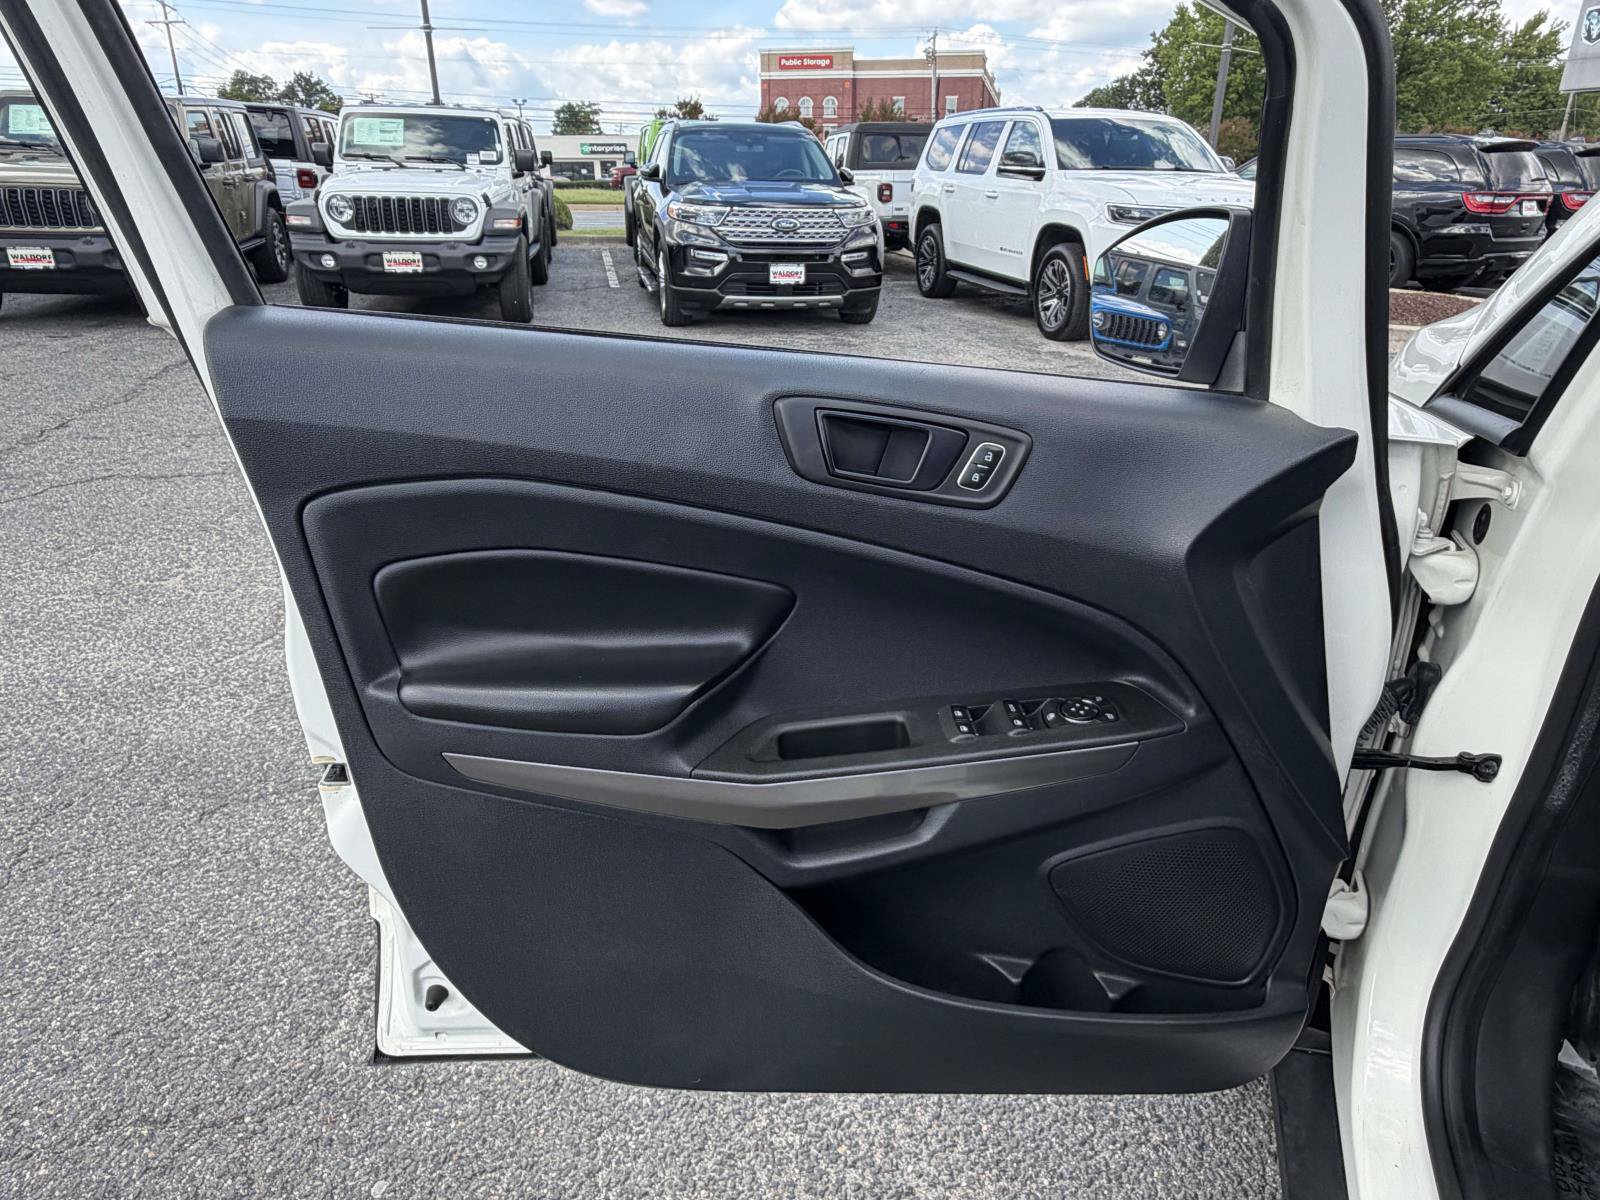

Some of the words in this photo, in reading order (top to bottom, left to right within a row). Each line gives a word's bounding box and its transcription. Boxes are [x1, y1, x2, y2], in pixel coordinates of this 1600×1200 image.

[781, 58, 802, 66] Public
[803, 58, 831, 67] Storage
[582, 144, 626, 153] enterprise
